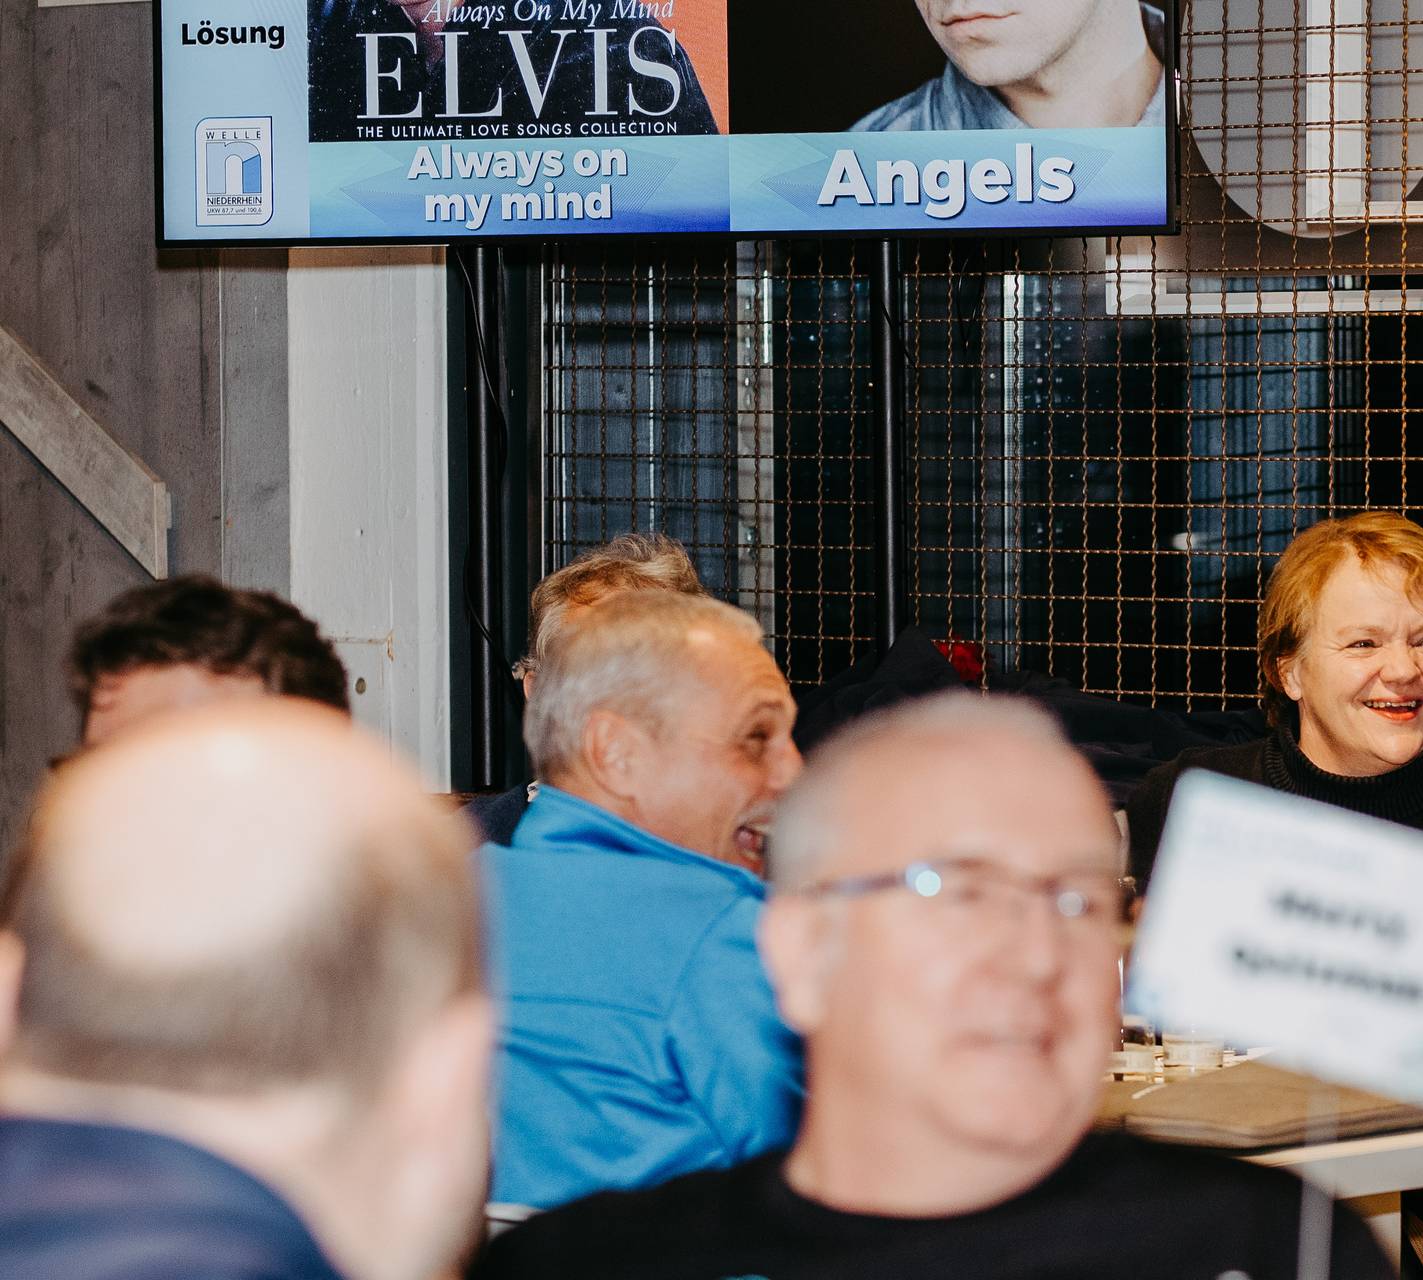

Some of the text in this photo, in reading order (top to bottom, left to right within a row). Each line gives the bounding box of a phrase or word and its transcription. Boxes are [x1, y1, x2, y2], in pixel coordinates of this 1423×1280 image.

[422, 0, 674, 29] Always On My Mind
[181, 20, 285, 50] Lösung
[356, 26, 682, 120] ELVIS
[205, 130, 261, 140] WELLE
[356, 121, 678, 138] THE ULTIMATE LOVE SONGS COLLECTION
[407, 144, 628, 187] Always on
[816, 143, 1076, 219] Angels
[206, 196, 262, 205] NIEDERRHEIN
[424, 181, 613, 230] my mind
